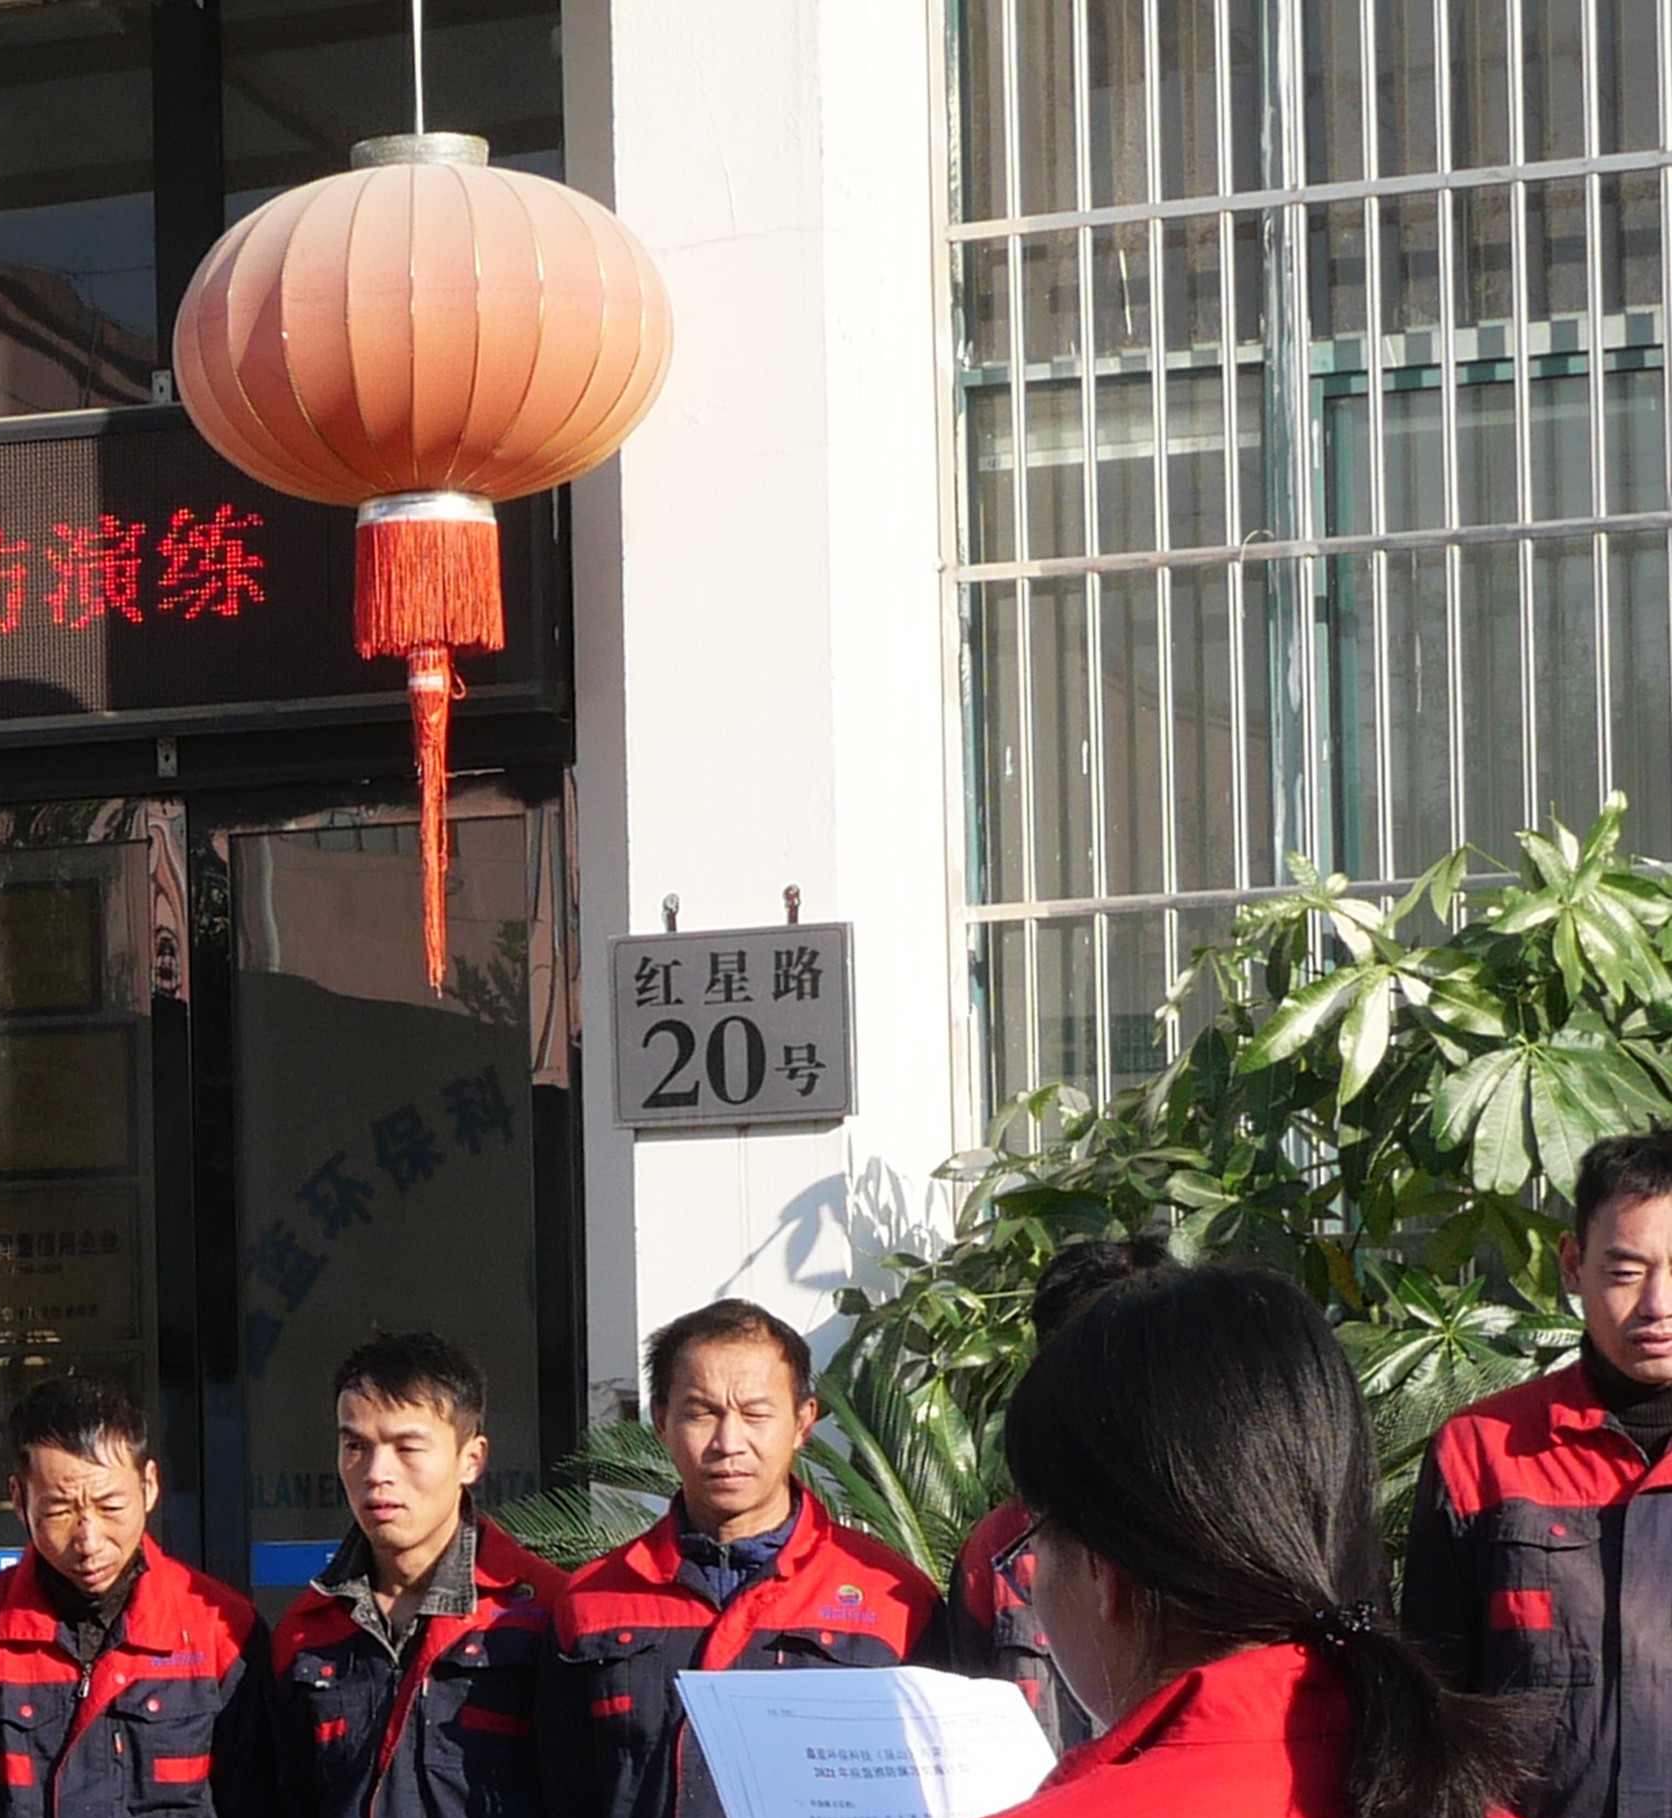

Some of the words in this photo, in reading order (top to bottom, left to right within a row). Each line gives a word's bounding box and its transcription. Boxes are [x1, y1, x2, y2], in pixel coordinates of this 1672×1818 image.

[633, 946, 824, 1008] 红星路
[641, 1015, 827, 1110] 20号
